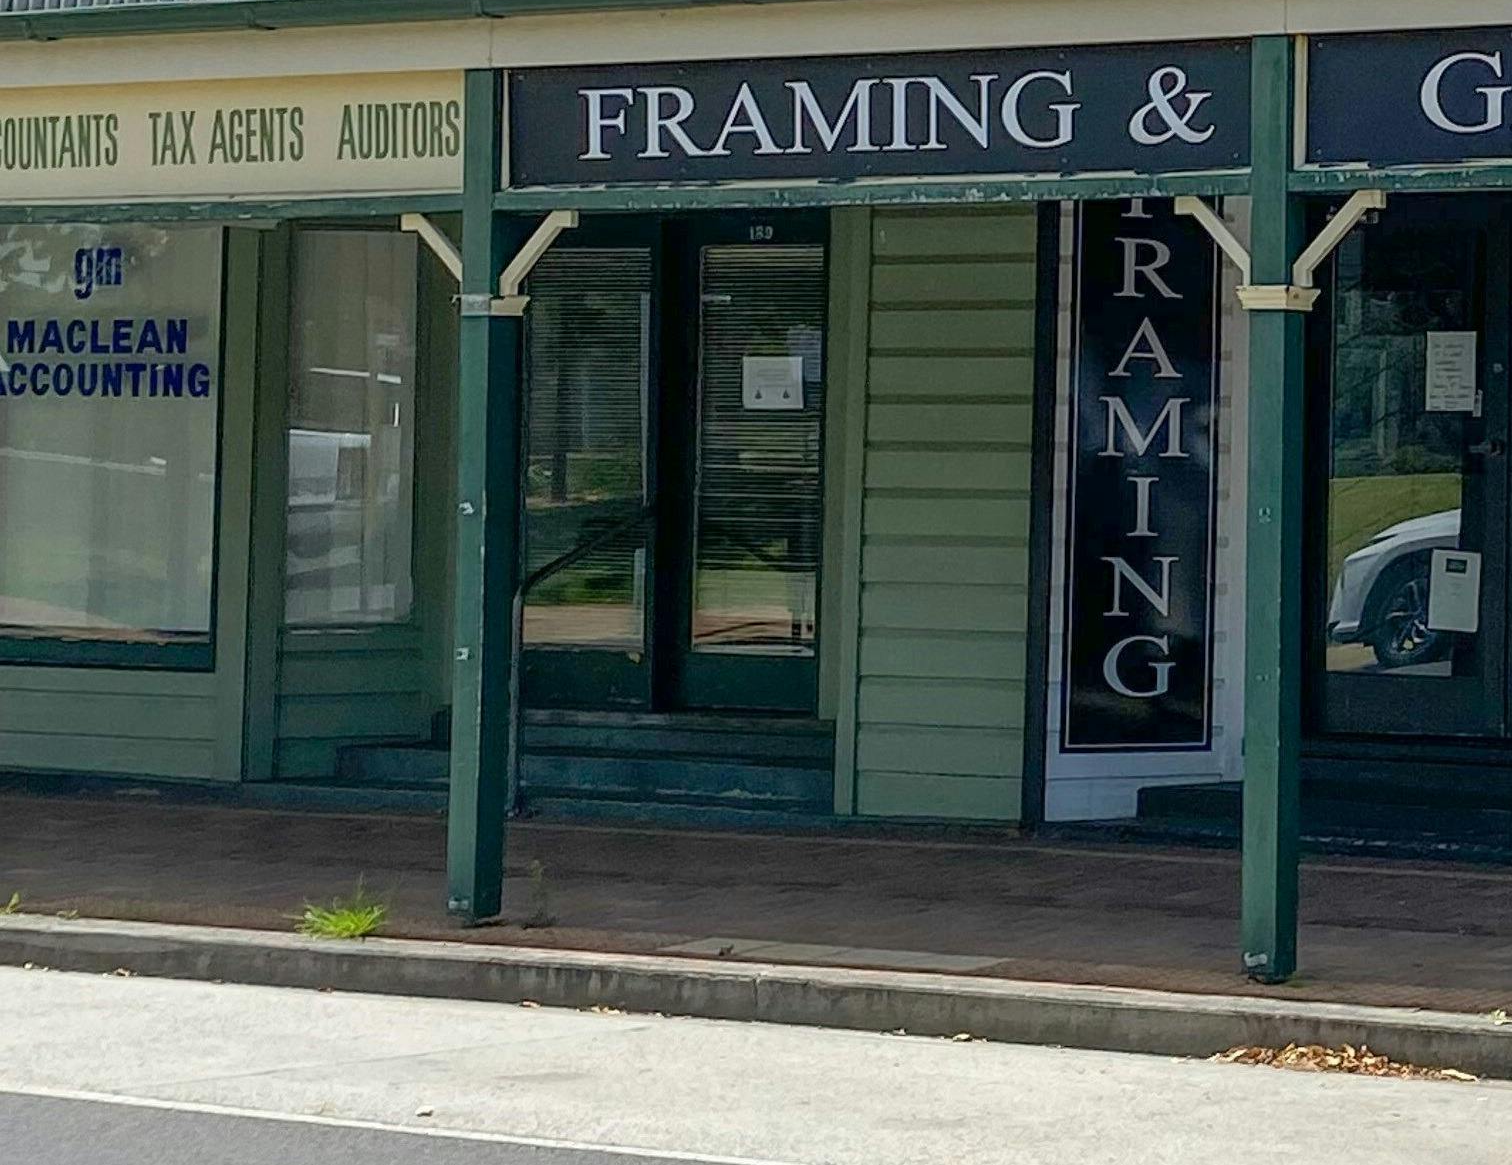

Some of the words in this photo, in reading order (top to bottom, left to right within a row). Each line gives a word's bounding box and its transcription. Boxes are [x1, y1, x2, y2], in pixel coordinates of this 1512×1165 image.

[0, 114, 119, 170] OUNTANTS
[148, 110, 197, 166] TAX
[207, 107, 304, 165] AGENTS
[336, 100, 461, 161] AUDITORS
[577, 68, 1082, 161] FRAMING
[1128, 65, 1216, 145] &
[7, 318, 188, 354] MACLEAN
[1096, 198, 1192, 698] RAMING
